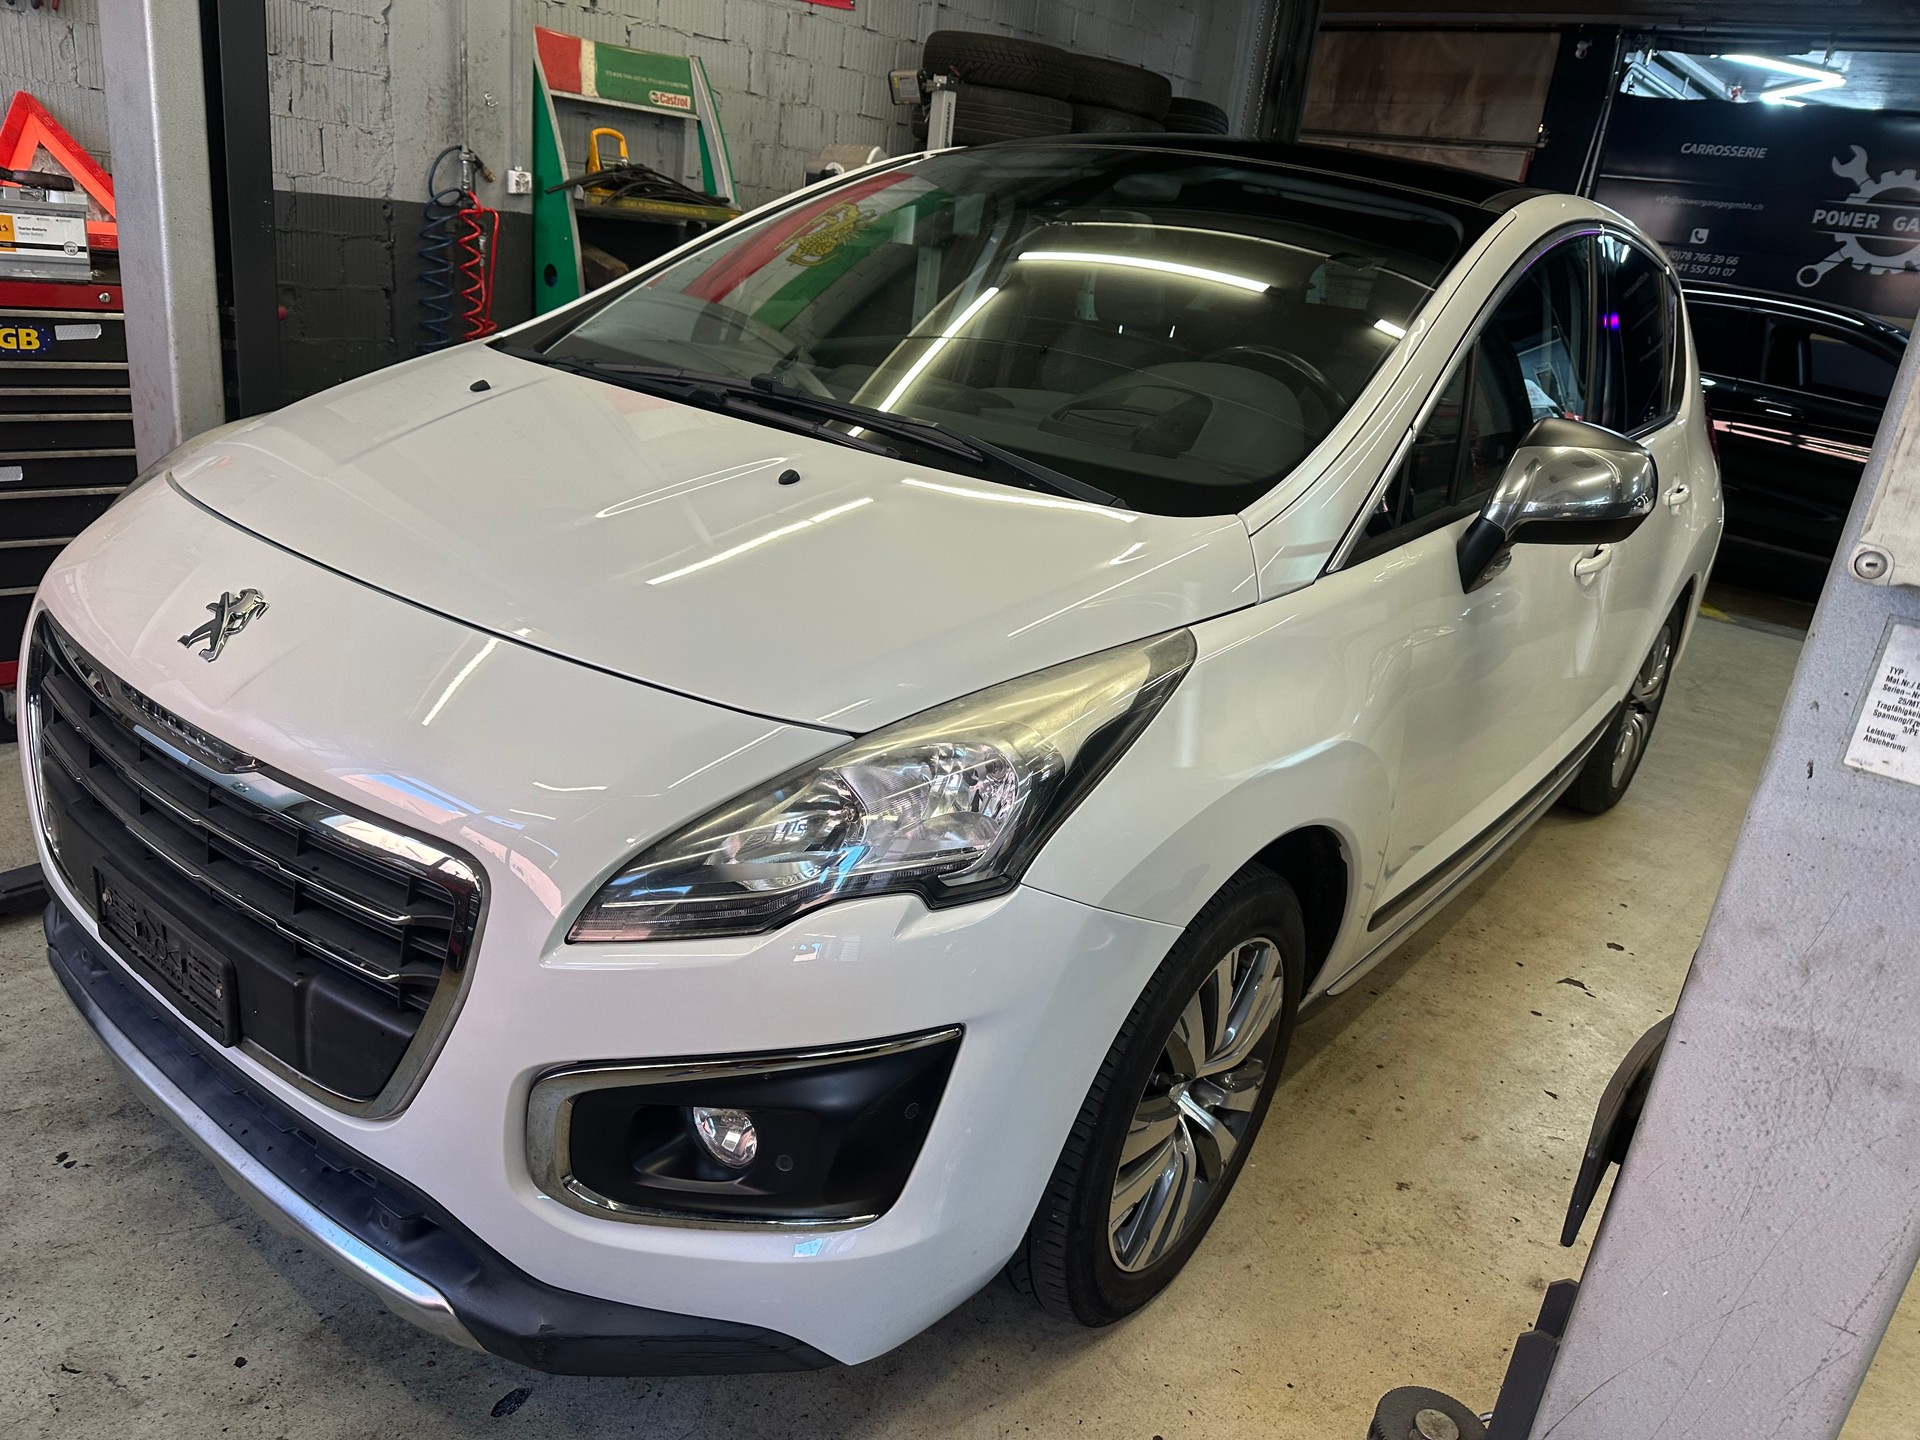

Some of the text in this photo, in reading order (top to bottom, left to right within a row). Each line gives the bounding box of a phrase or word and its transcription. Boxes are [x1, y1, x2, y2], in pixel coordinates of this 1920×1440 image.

[660, 93, 689, 108] Castrol
[1681, 143, 1768, 158] CARROSSERIE
[1812, 209, 1880, 229] POWER
[1693, 252, 1712, 263] 766
[1712, 254, 1725, 264] 39
[1726, 256, 1740, 265] 66
[1690, 264, 1709, 274] 557
[1709, 266, 1721, 275] 01
[1722, 268, 1736, 277] 07
